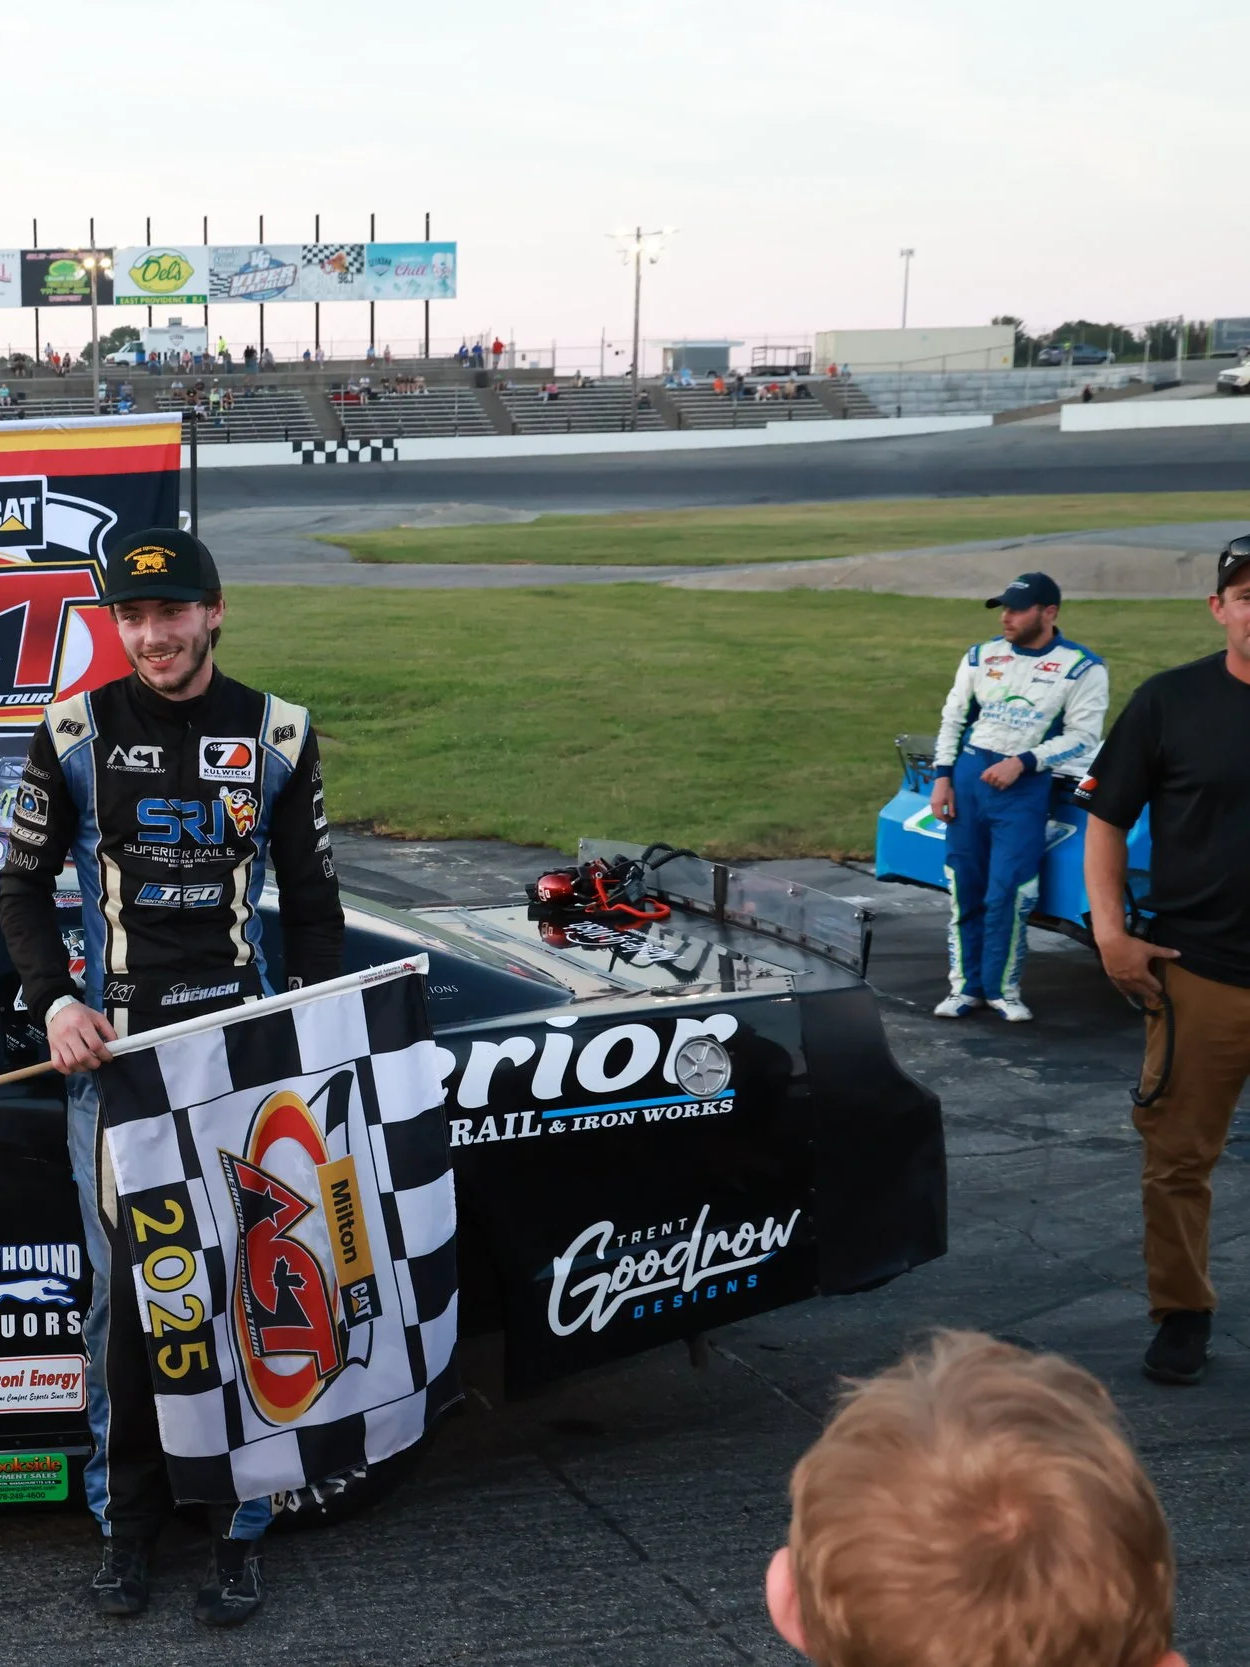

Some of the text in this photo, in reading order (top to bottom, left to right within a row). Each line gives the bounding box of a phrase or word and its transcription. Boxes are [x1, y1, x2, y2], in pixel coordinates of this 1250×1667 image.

[232, 266, 295, 287] VIPER
[120, 297, 138, 305] EAST
[140, 296, 187, 304] PROVIDENCE
[106, 744, 164, 768] ACT
[203, 768, 251, 776] KULWICKI
[151, 855, 169, 863] IRON
[194, 847, 223, 858] RAIL
[226, 847, 236, 857] &
[103, 981, 136, 1002] K1
[161, 981, 240, 1006] GLUCHACKI
[449, 1098, 735, 1147] RAIL & IRON WORKS
[617, 1217, 688, 1248] TRENT
[221, 1152, 246, 1238] AMERICAN
[247, 1317, 262, 1359] TOUR
[330, 1178, 373, 1319] Milton CAT
[233, 1160, 340, 1376] ACT
[547, 1203, 801, 1337] Goodrow
[130, 1198, 210, 1381] 2025
[633, 1274, 758, 1319] DESIGNS
[30, 1369, 81, 1390] Energy
[7, 1393, 28, 1403] Comfort
[29, 1392, 49, 1402] Experts
[50, 1391, 64, 1400] Since
